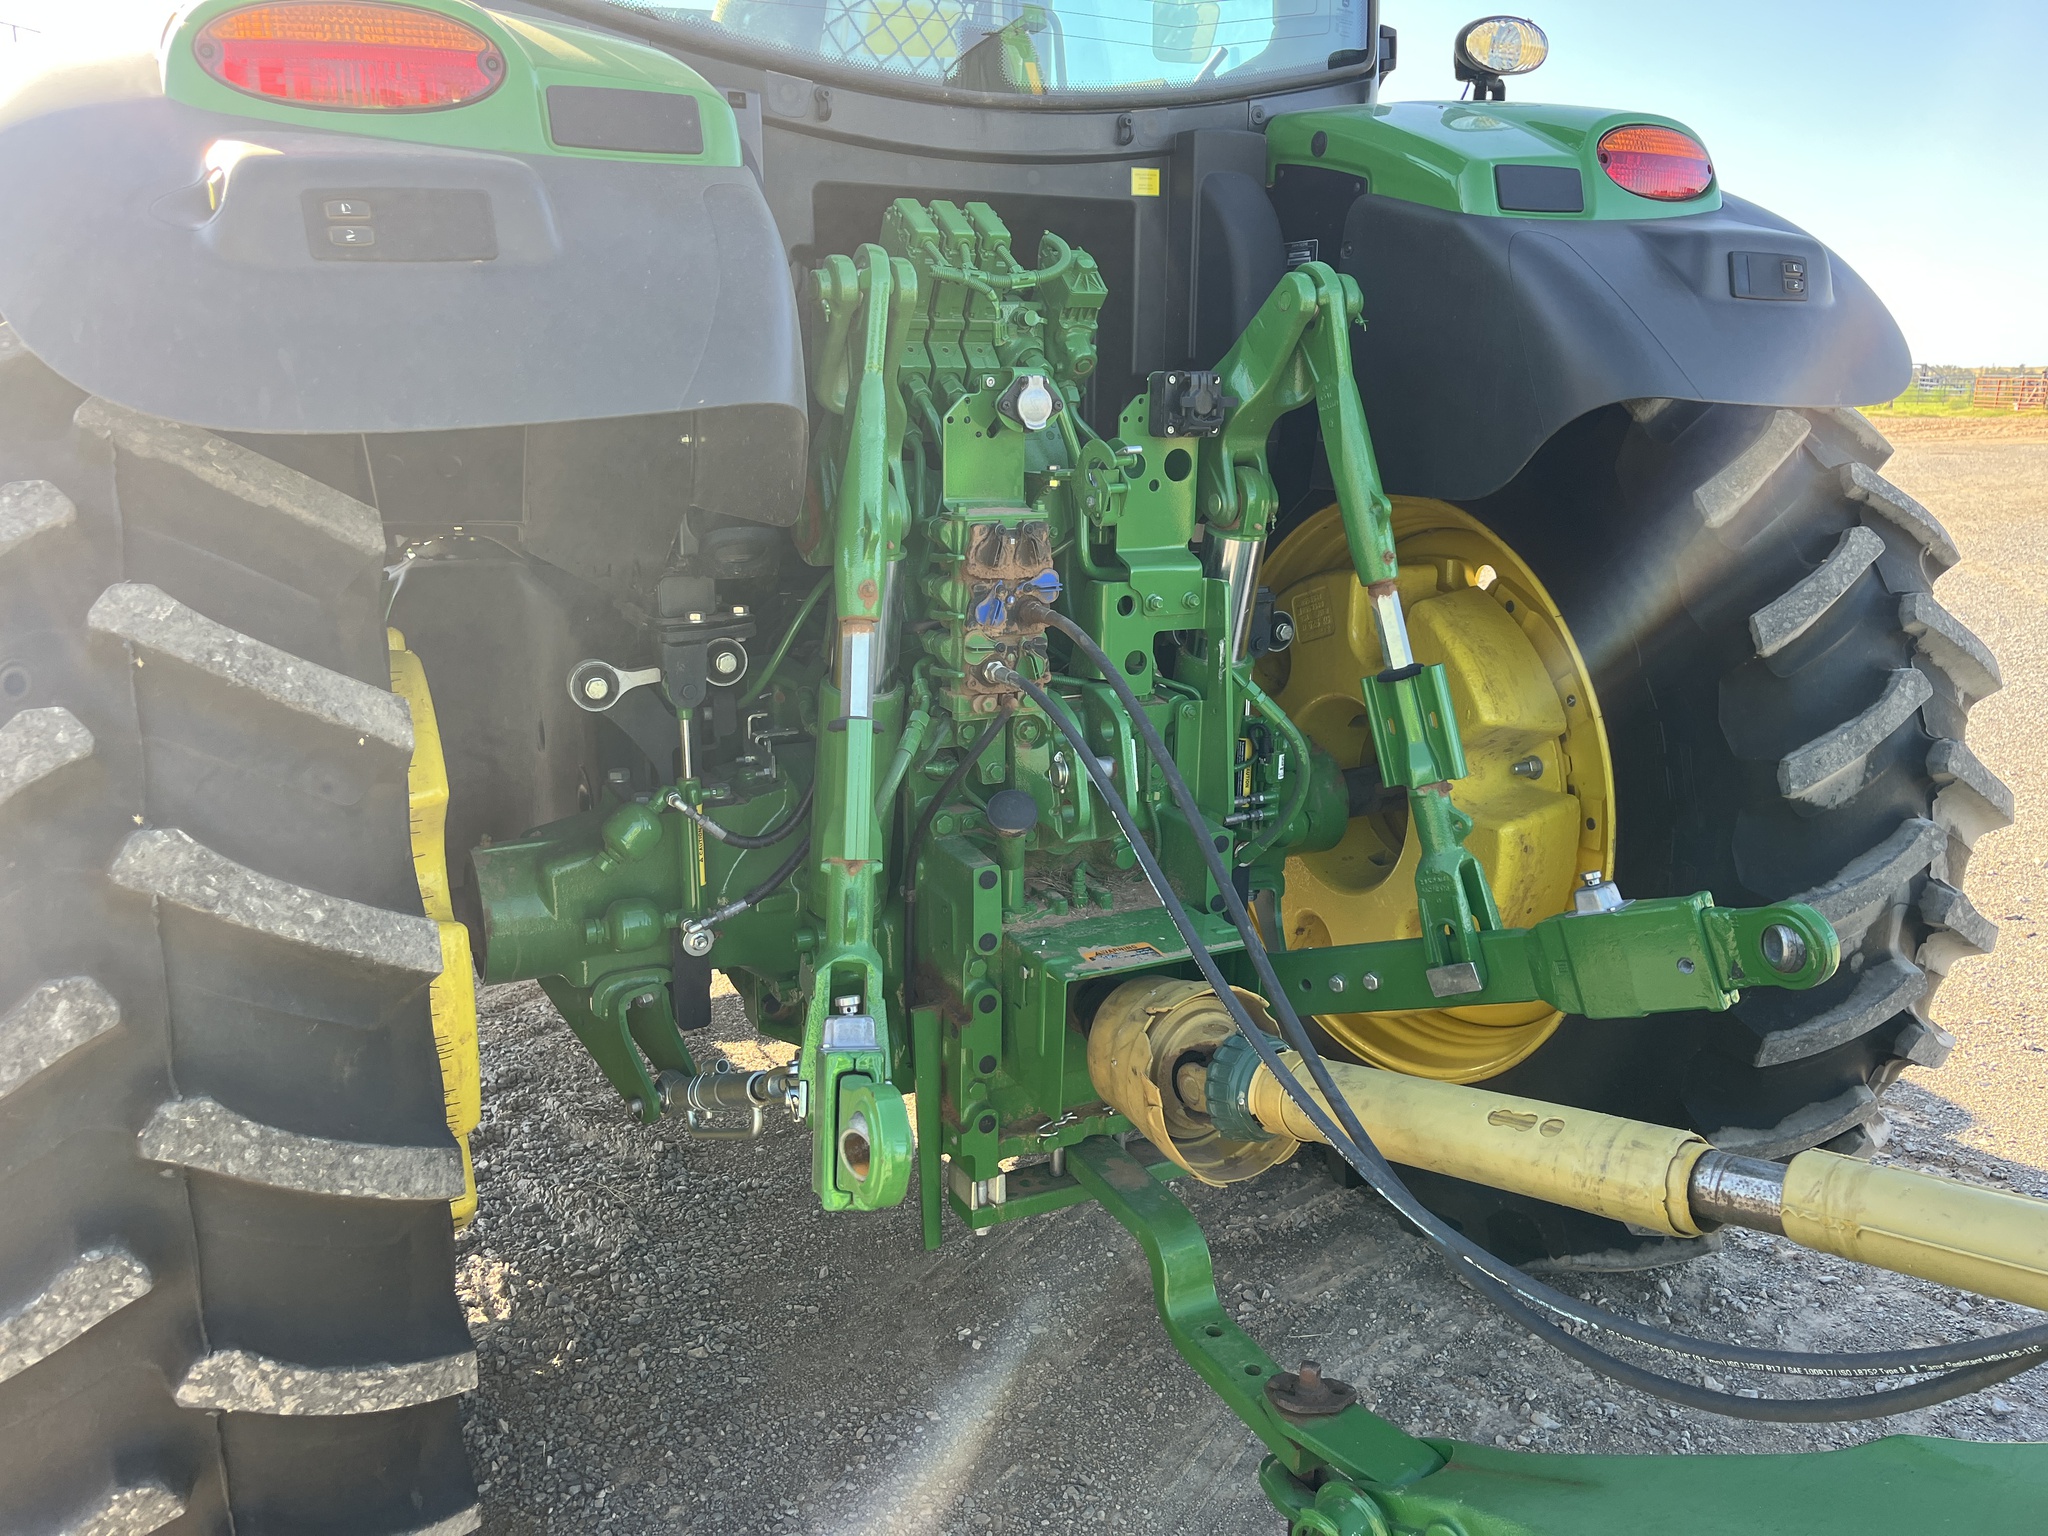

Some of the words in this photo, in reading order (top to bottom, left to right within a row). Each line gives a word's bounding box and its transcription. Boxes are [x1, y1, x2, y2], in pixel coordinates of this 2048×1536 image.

[1100, 944, 1138, 955] WARNING
[1787, 1366, 1802, 1375] SAE
[1853, 1368, 1879, 1377] 18752
[1880, 1367, 1900, 1376] Type
[1984, 1353, 2010, 1365] MSHA
